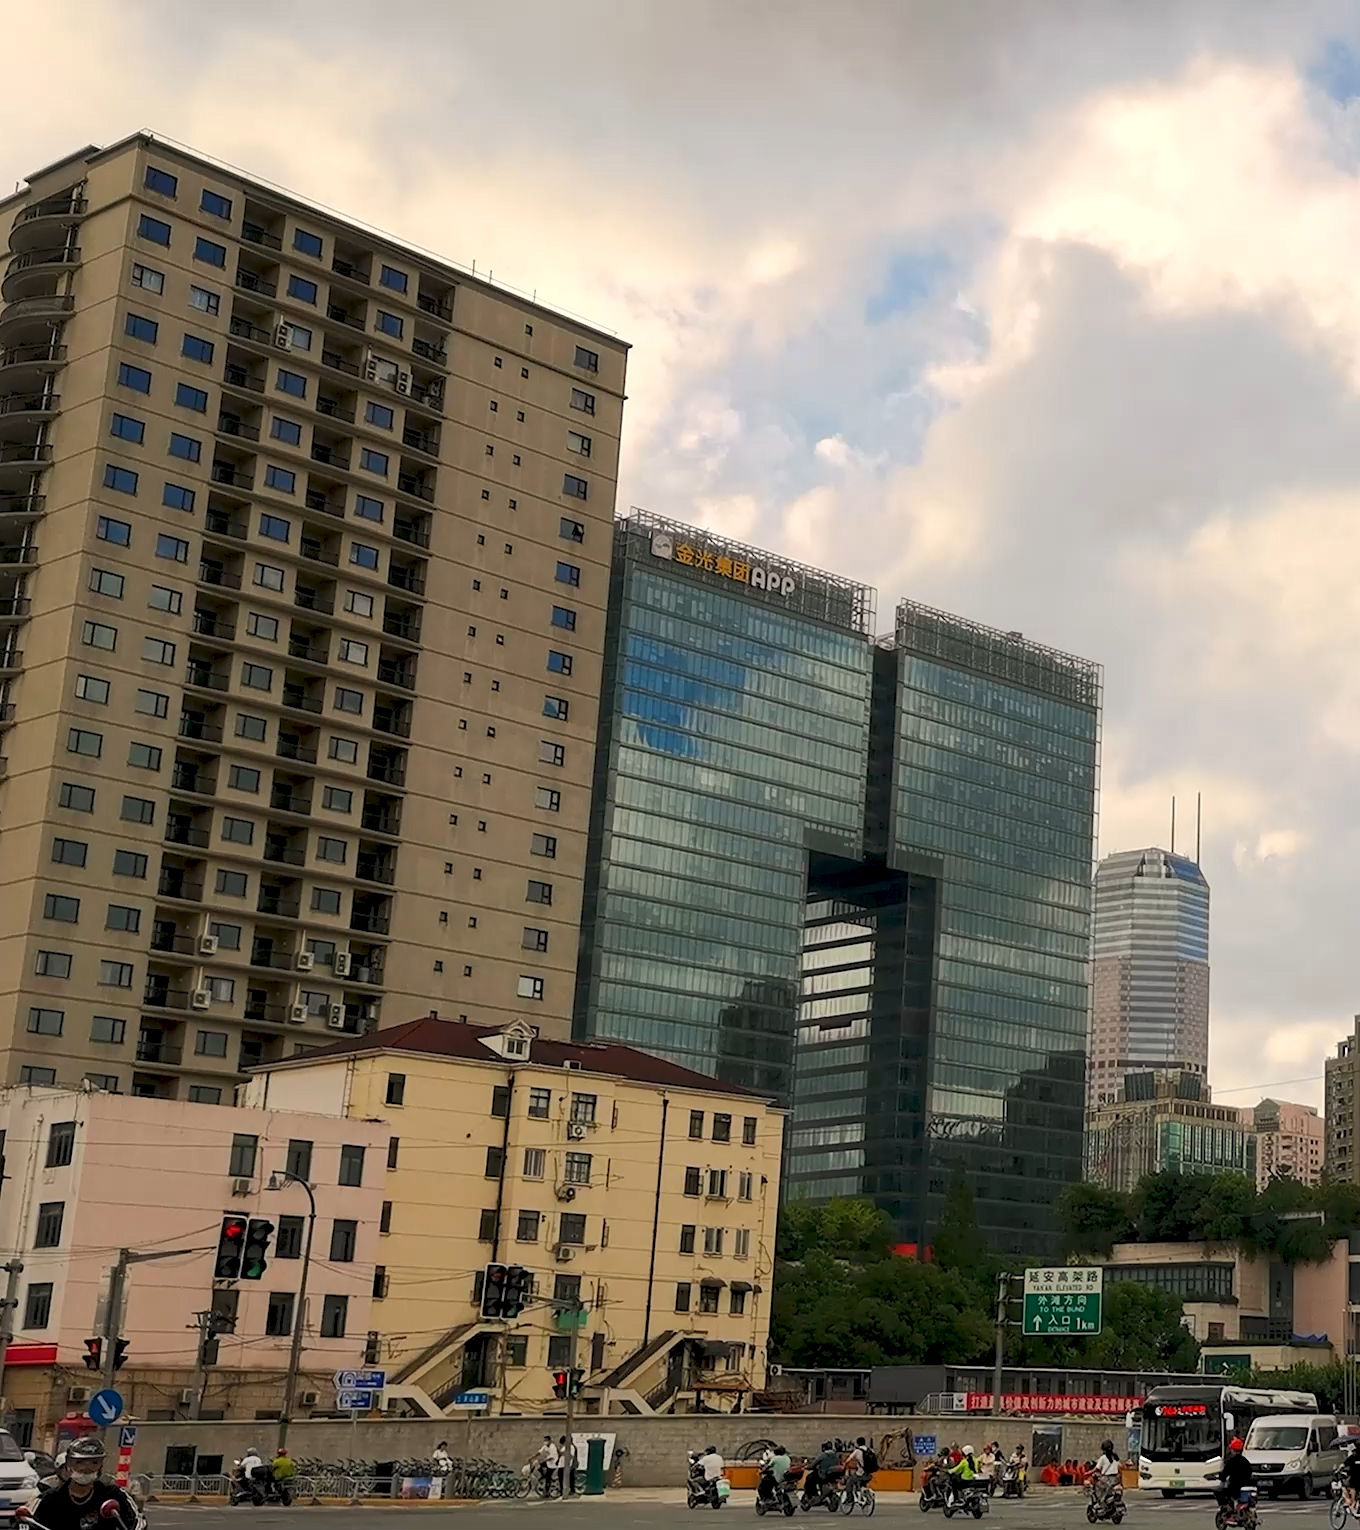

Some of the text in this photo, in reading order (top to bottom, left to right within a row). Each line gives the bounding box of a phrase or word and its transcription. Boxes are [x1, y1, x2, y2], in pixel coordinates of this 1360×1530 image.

[675, 543, 795, 596] 金光集团 APP
[1028, 1270, 1098, 1283] 延安高架路
[1037, 1294, 1087, 1306] 外滩方向
[1047, 1314, 1071, 1325] 入口
